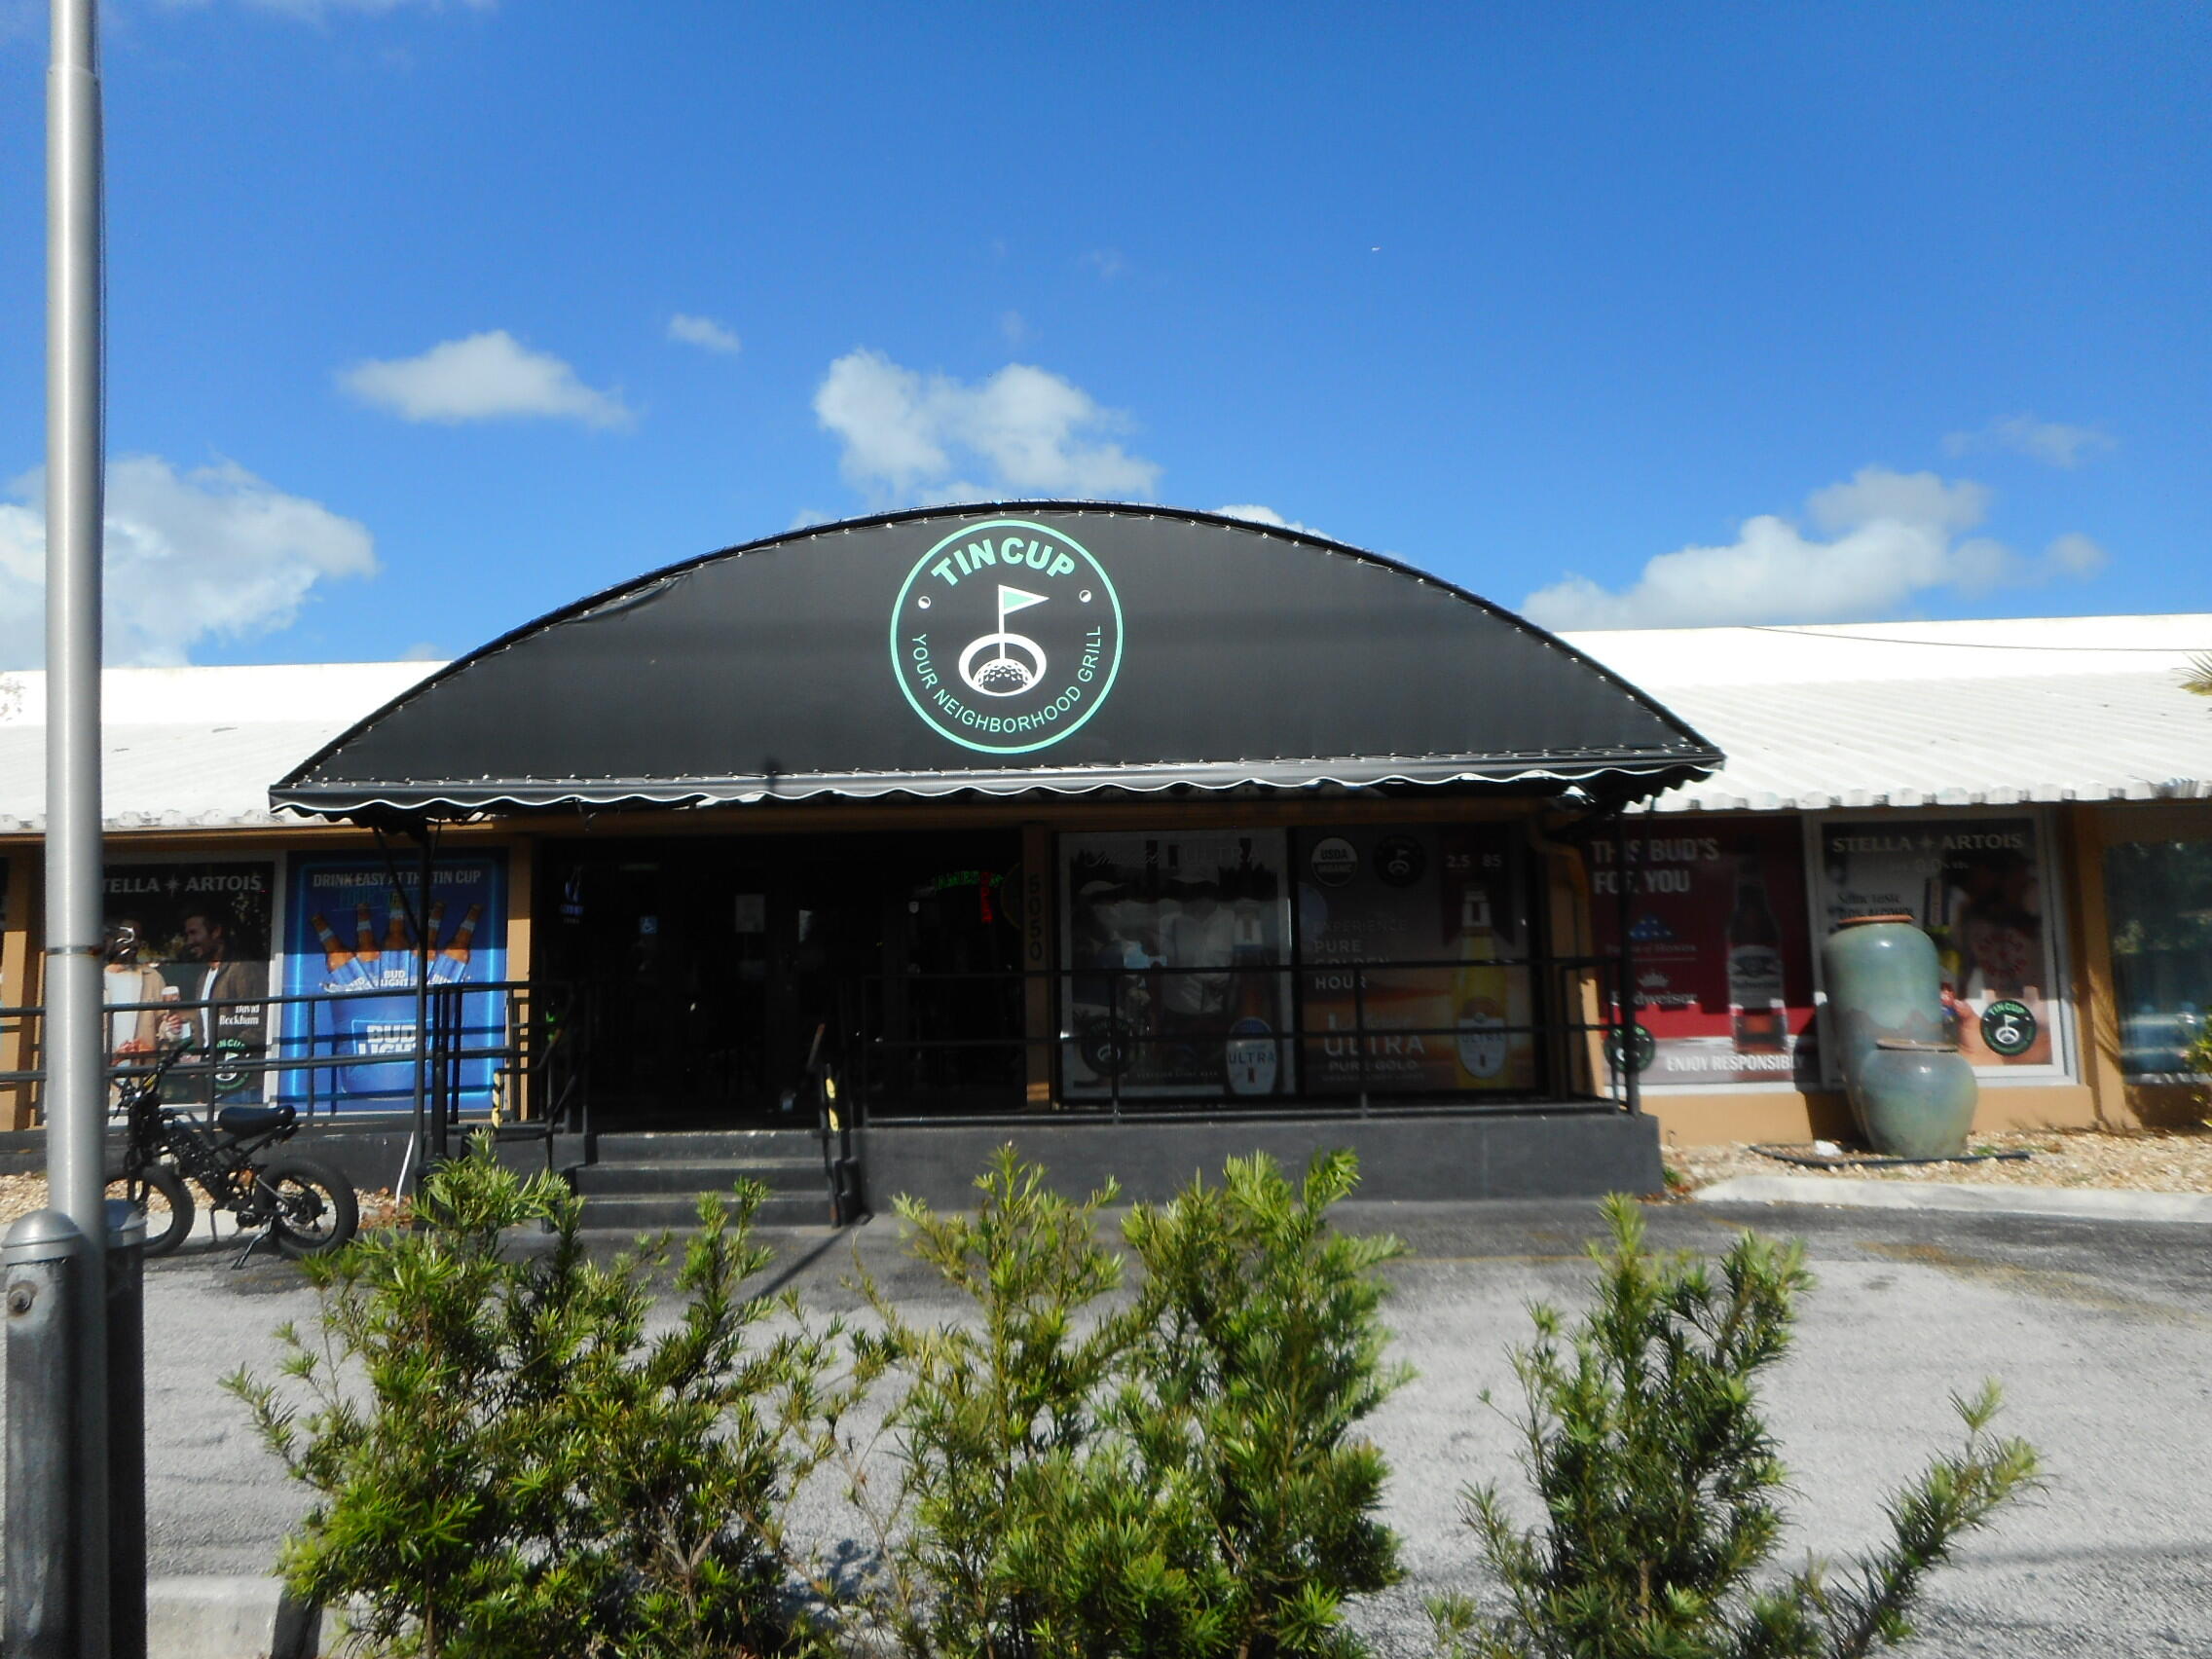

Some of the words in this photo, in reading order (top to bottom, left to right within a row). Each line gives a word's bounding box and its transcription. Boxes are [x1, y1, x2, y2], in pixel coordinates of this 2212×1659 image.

[912, 634, 939, 689] YOUR
[933, 685, 1081, 733] NEIGHBORHOOD
[1078, 625, 1101, 682] GRILL
[1650, 837, 1719, 863] BUD'S
[1832, 837, 1913, 854] STELLA
[1940, 833, 2026, 850] ARTOIS
[98, 877, 161, 894] TELLA
[184, 874, 263, 892] ARTOIS
[455, 869, 482, 884] CUP
[1644, 869, 1691, 894] YOU
[1314, 939, 1363, 954] PURE
[384, 970, 406, 979] BUD
[366, 1024, 418, 1045] BUD
[1228, 1051, 1276, 1065] ULTRA
[1666, 1054, 1708, 1072] ENJOY
